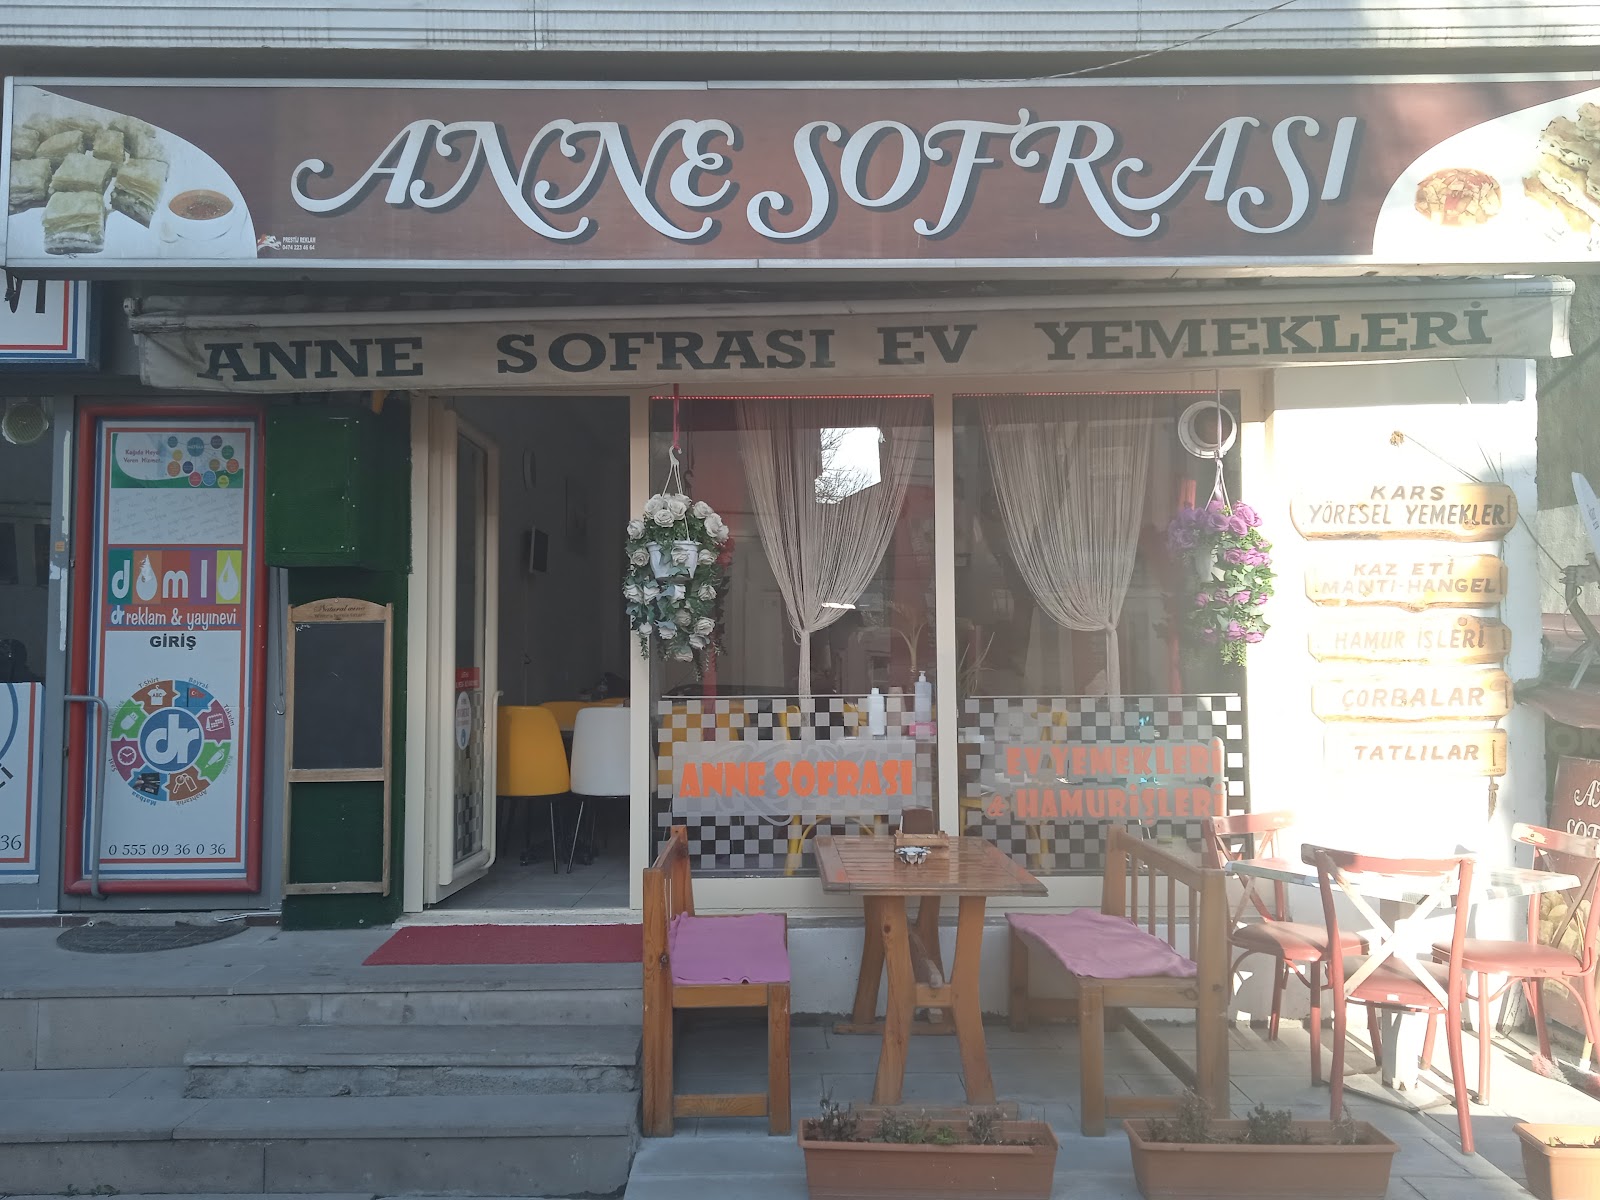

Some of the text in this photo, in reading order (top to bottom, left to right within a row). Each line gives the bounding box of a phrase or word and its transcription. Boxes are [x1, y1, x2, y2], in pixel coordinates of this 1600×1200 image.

[290, 106, 1358, 241] ANNE SOFRASI
[197, 301, 1494, 382] ANNE SOFRASI EV YEMEKLERİ
[1371, 485, 1446, 502] KARS
[1309, 500, 1392, 525] YÖRESEL
[1354, 558, 1455, 577] KAZ ETİ
[126, 606, 167, 626] reklam
[170, 607, 183, 626] &
[187, 608, 237, 631] yayınevi
[149, 633, 197, 651] GİRİŞ
[1335, 631, 1405, 650] HAMUR
[138, 677, 159, 689] T-Shirt
[1341, 686, 1485, 712] ÇORBALAR
[145, 713, 199, 764] dr
[1005, 738, 1221, 776] EV YEMEKLERİ
[1354, 745, 1479, 761] TATLILAR
[679, 759, 913, 798] ANNE SOFRASI
[131, 791, 157, 807] Matbaa
[986, 795, 1006, 817] &
[0, 833, 22, 851] 36
[108, 843, 227, 856] 0 555 09 36 0 36
